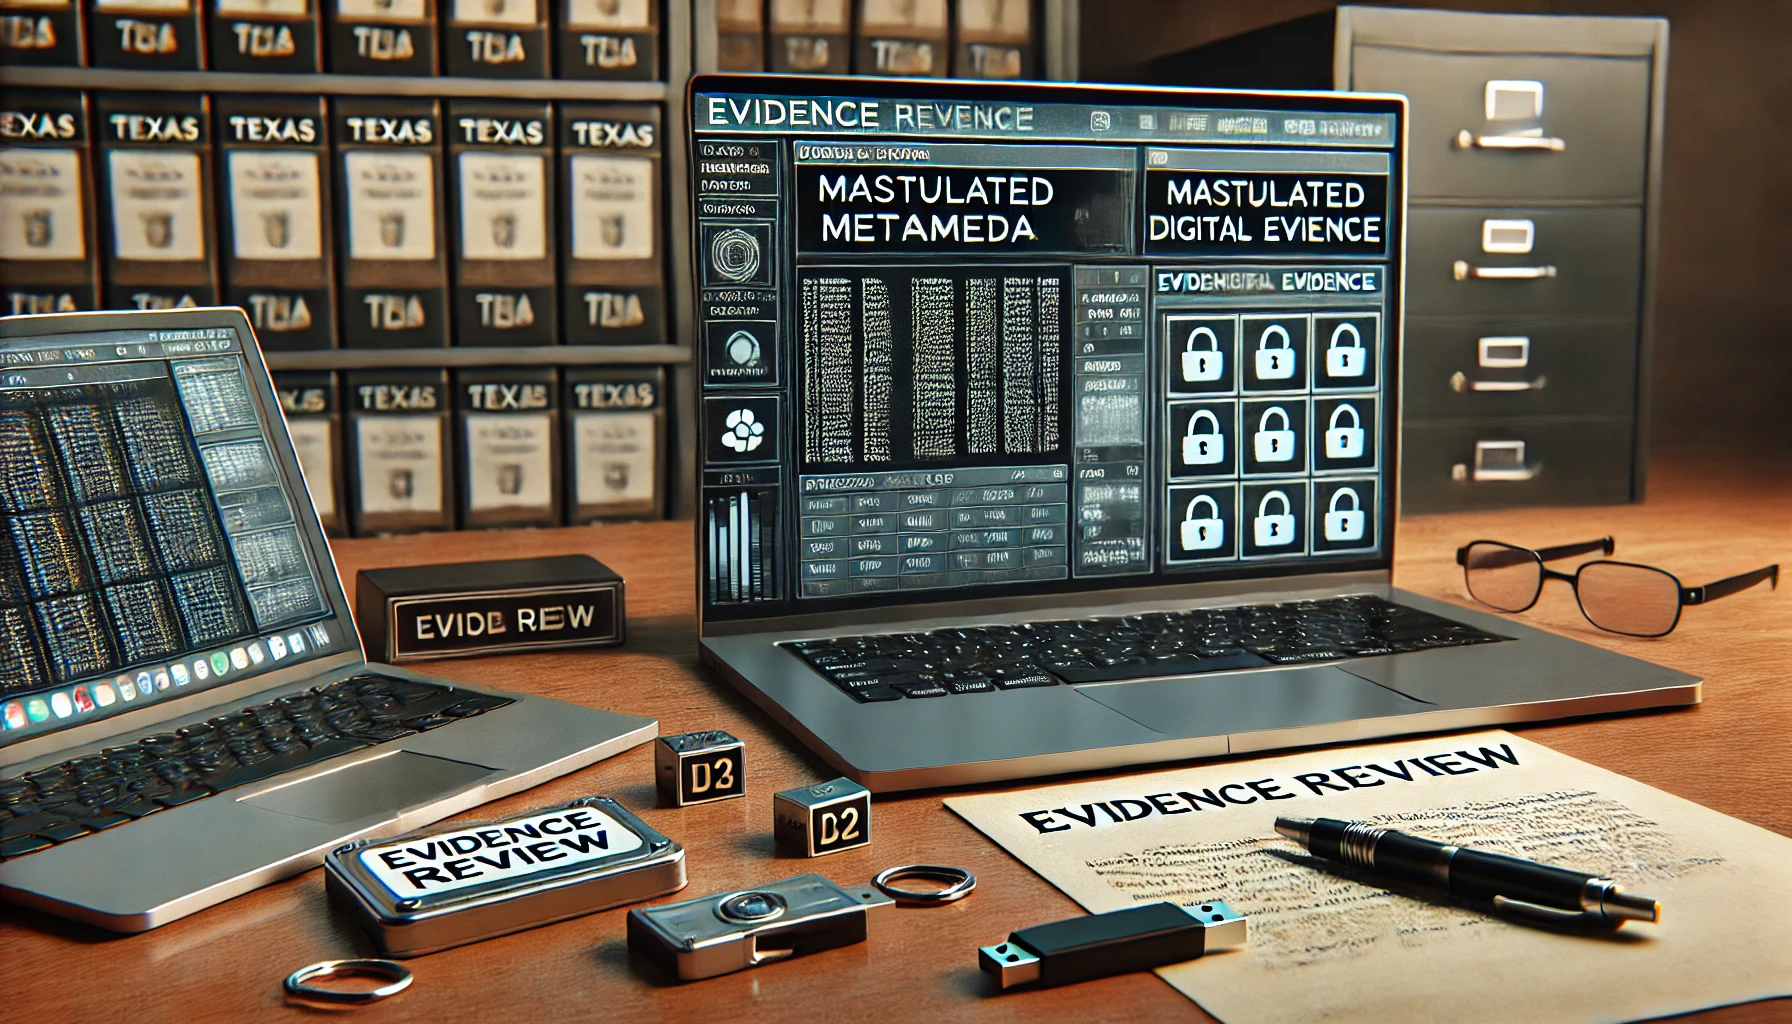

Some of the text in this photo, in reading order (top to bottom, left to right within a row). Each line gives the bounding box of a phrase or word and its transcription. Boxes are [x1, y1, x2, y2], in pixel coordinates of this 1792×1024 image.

[708, 97, 880, 127] EVIDENCE
[109, 113, 199, 141] TEXAS
[229, 115, 315, 142] TEXAS
[346, 117, 433, 144] TEXAS
[459, 118, 544, 145] TEXAS
[572, 121, 653, 147] TEXAS
[819, 174, 1054, 206] MASTULATED
[1166, 179, 1365, 208] MASTULATED
[822, 213, 1038, 243] METAMEDA
[1150, 215, 1381, 243] DIGITAL EVIENCE
[1282, 272, 1376, 292] EVIDENCE
[359, 385, 437, 410] TEXAS
[468, 384, 548, 409] TEXAS
[575, 383, 654, 409] TEXAS
[692, 757, 733, 793] D3
[1019, 743, 1520, 834] EVIDENCE REVIEW
[820, 807, 860, 844] D2
[378, 811, 602, 870] EVIDENCE
[402, 829, 609, 889] REVIEW
